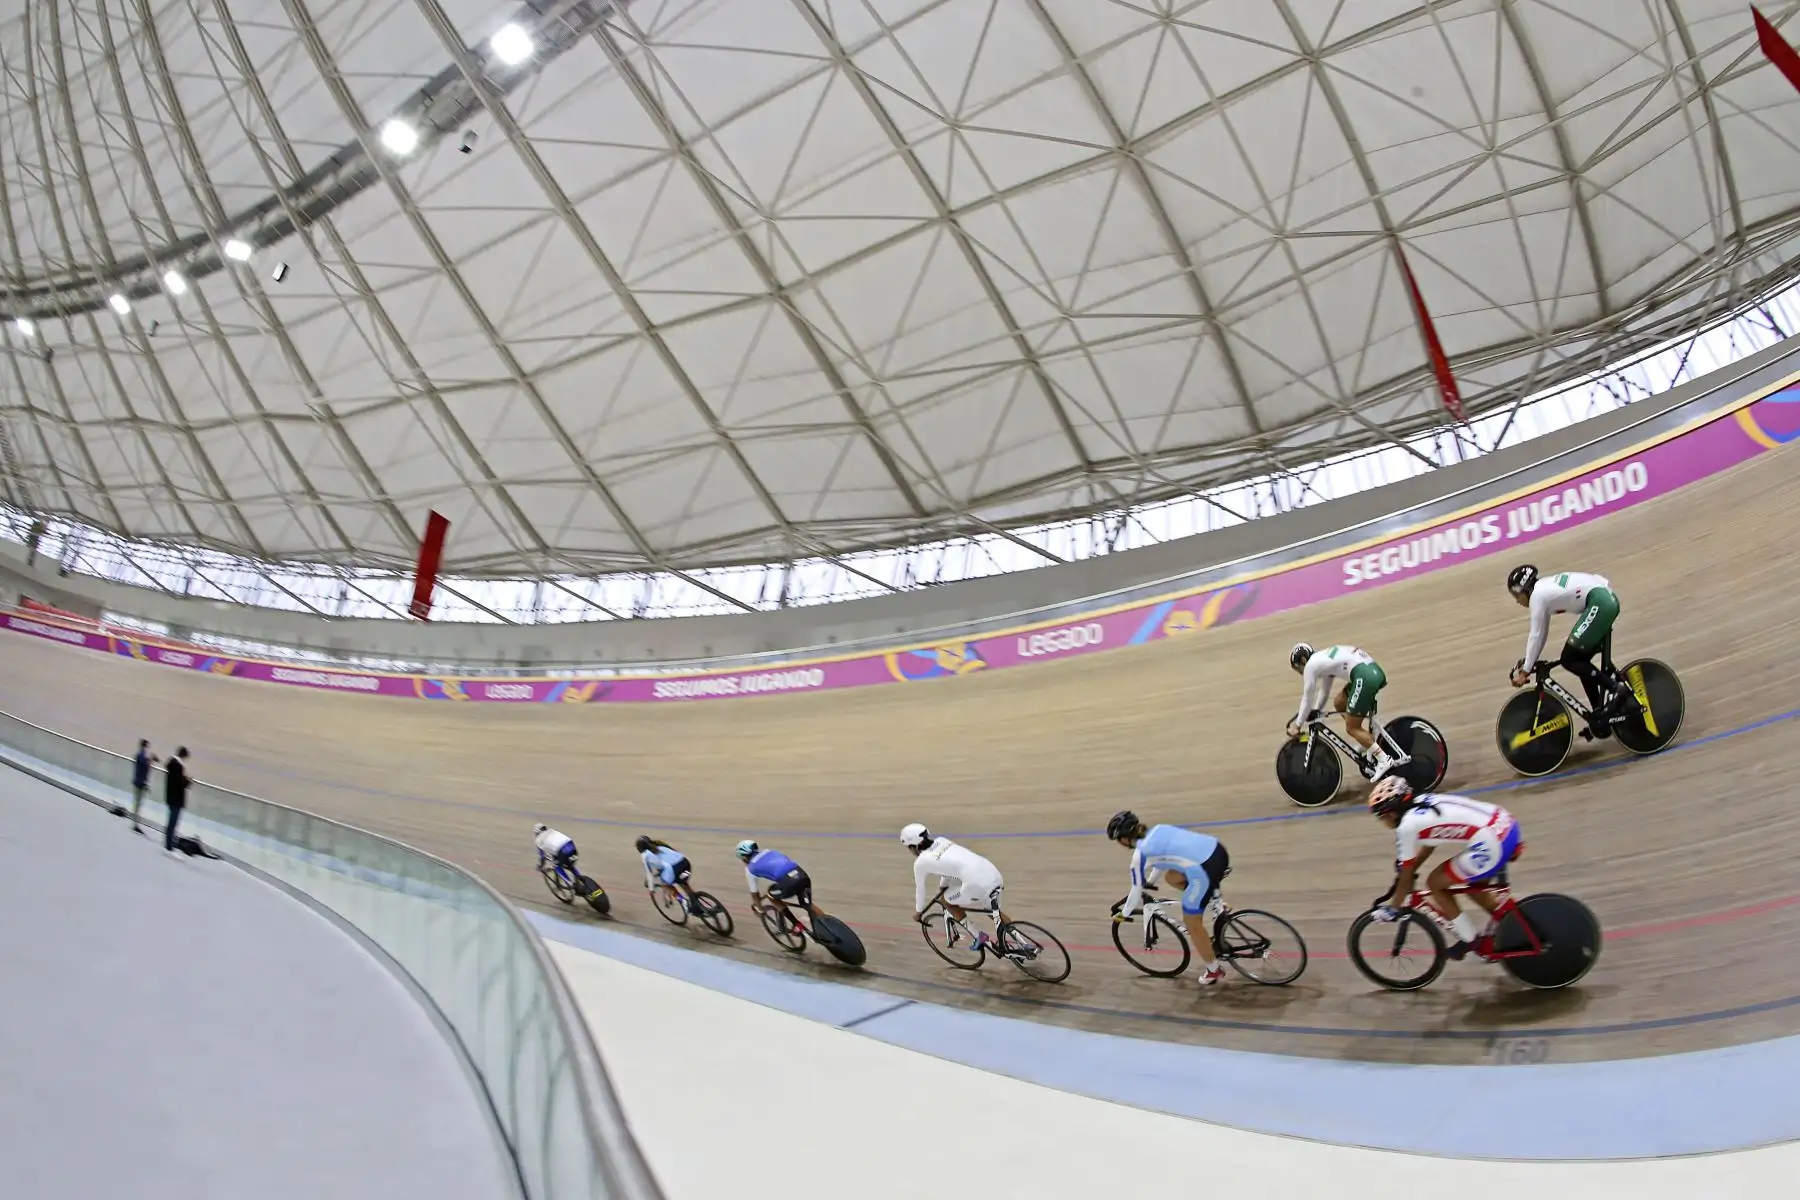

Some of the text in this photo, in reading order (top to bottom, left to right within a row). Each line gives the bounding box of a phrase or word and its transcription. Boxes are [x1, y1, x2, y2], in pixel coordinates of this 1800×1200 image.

[1343, 461, 1649, 587] SEGUIMOS JUGANDO
[1574, 605, 1599, 639] MEXICO
[1349, 678, 1363, 709] MEXICO
[1544, 677, 1588, 716] LOOK
[1322, 728, 1360, 762] LOOK
